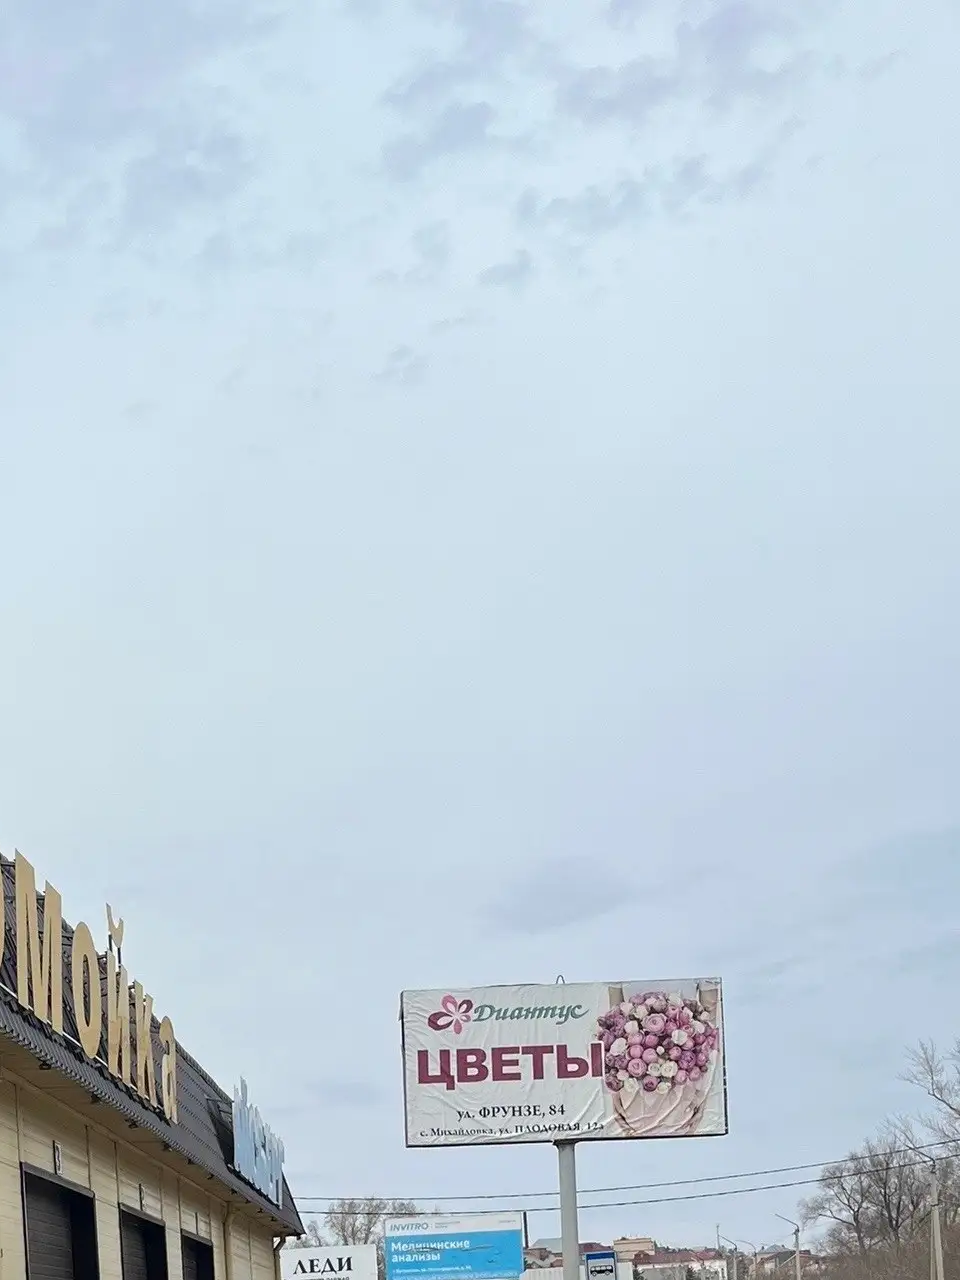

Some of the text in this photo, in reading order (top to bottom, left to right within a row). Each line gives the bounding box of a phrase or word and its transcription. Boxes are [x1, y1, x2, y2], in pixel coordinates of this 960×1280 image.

[473, 1001, 589, 1025] Диантус
[417, 1043, 604, 1090] ЦВЕТЫ
[456, 1104, 566, 1122] ул. ФРУНЗЕ, 84
[390, 1222, 429, 1232] INVITRO
[293, 1256, 353, 1275] ЛЕДИ
[391, 1253, 441, 1263] анализы
